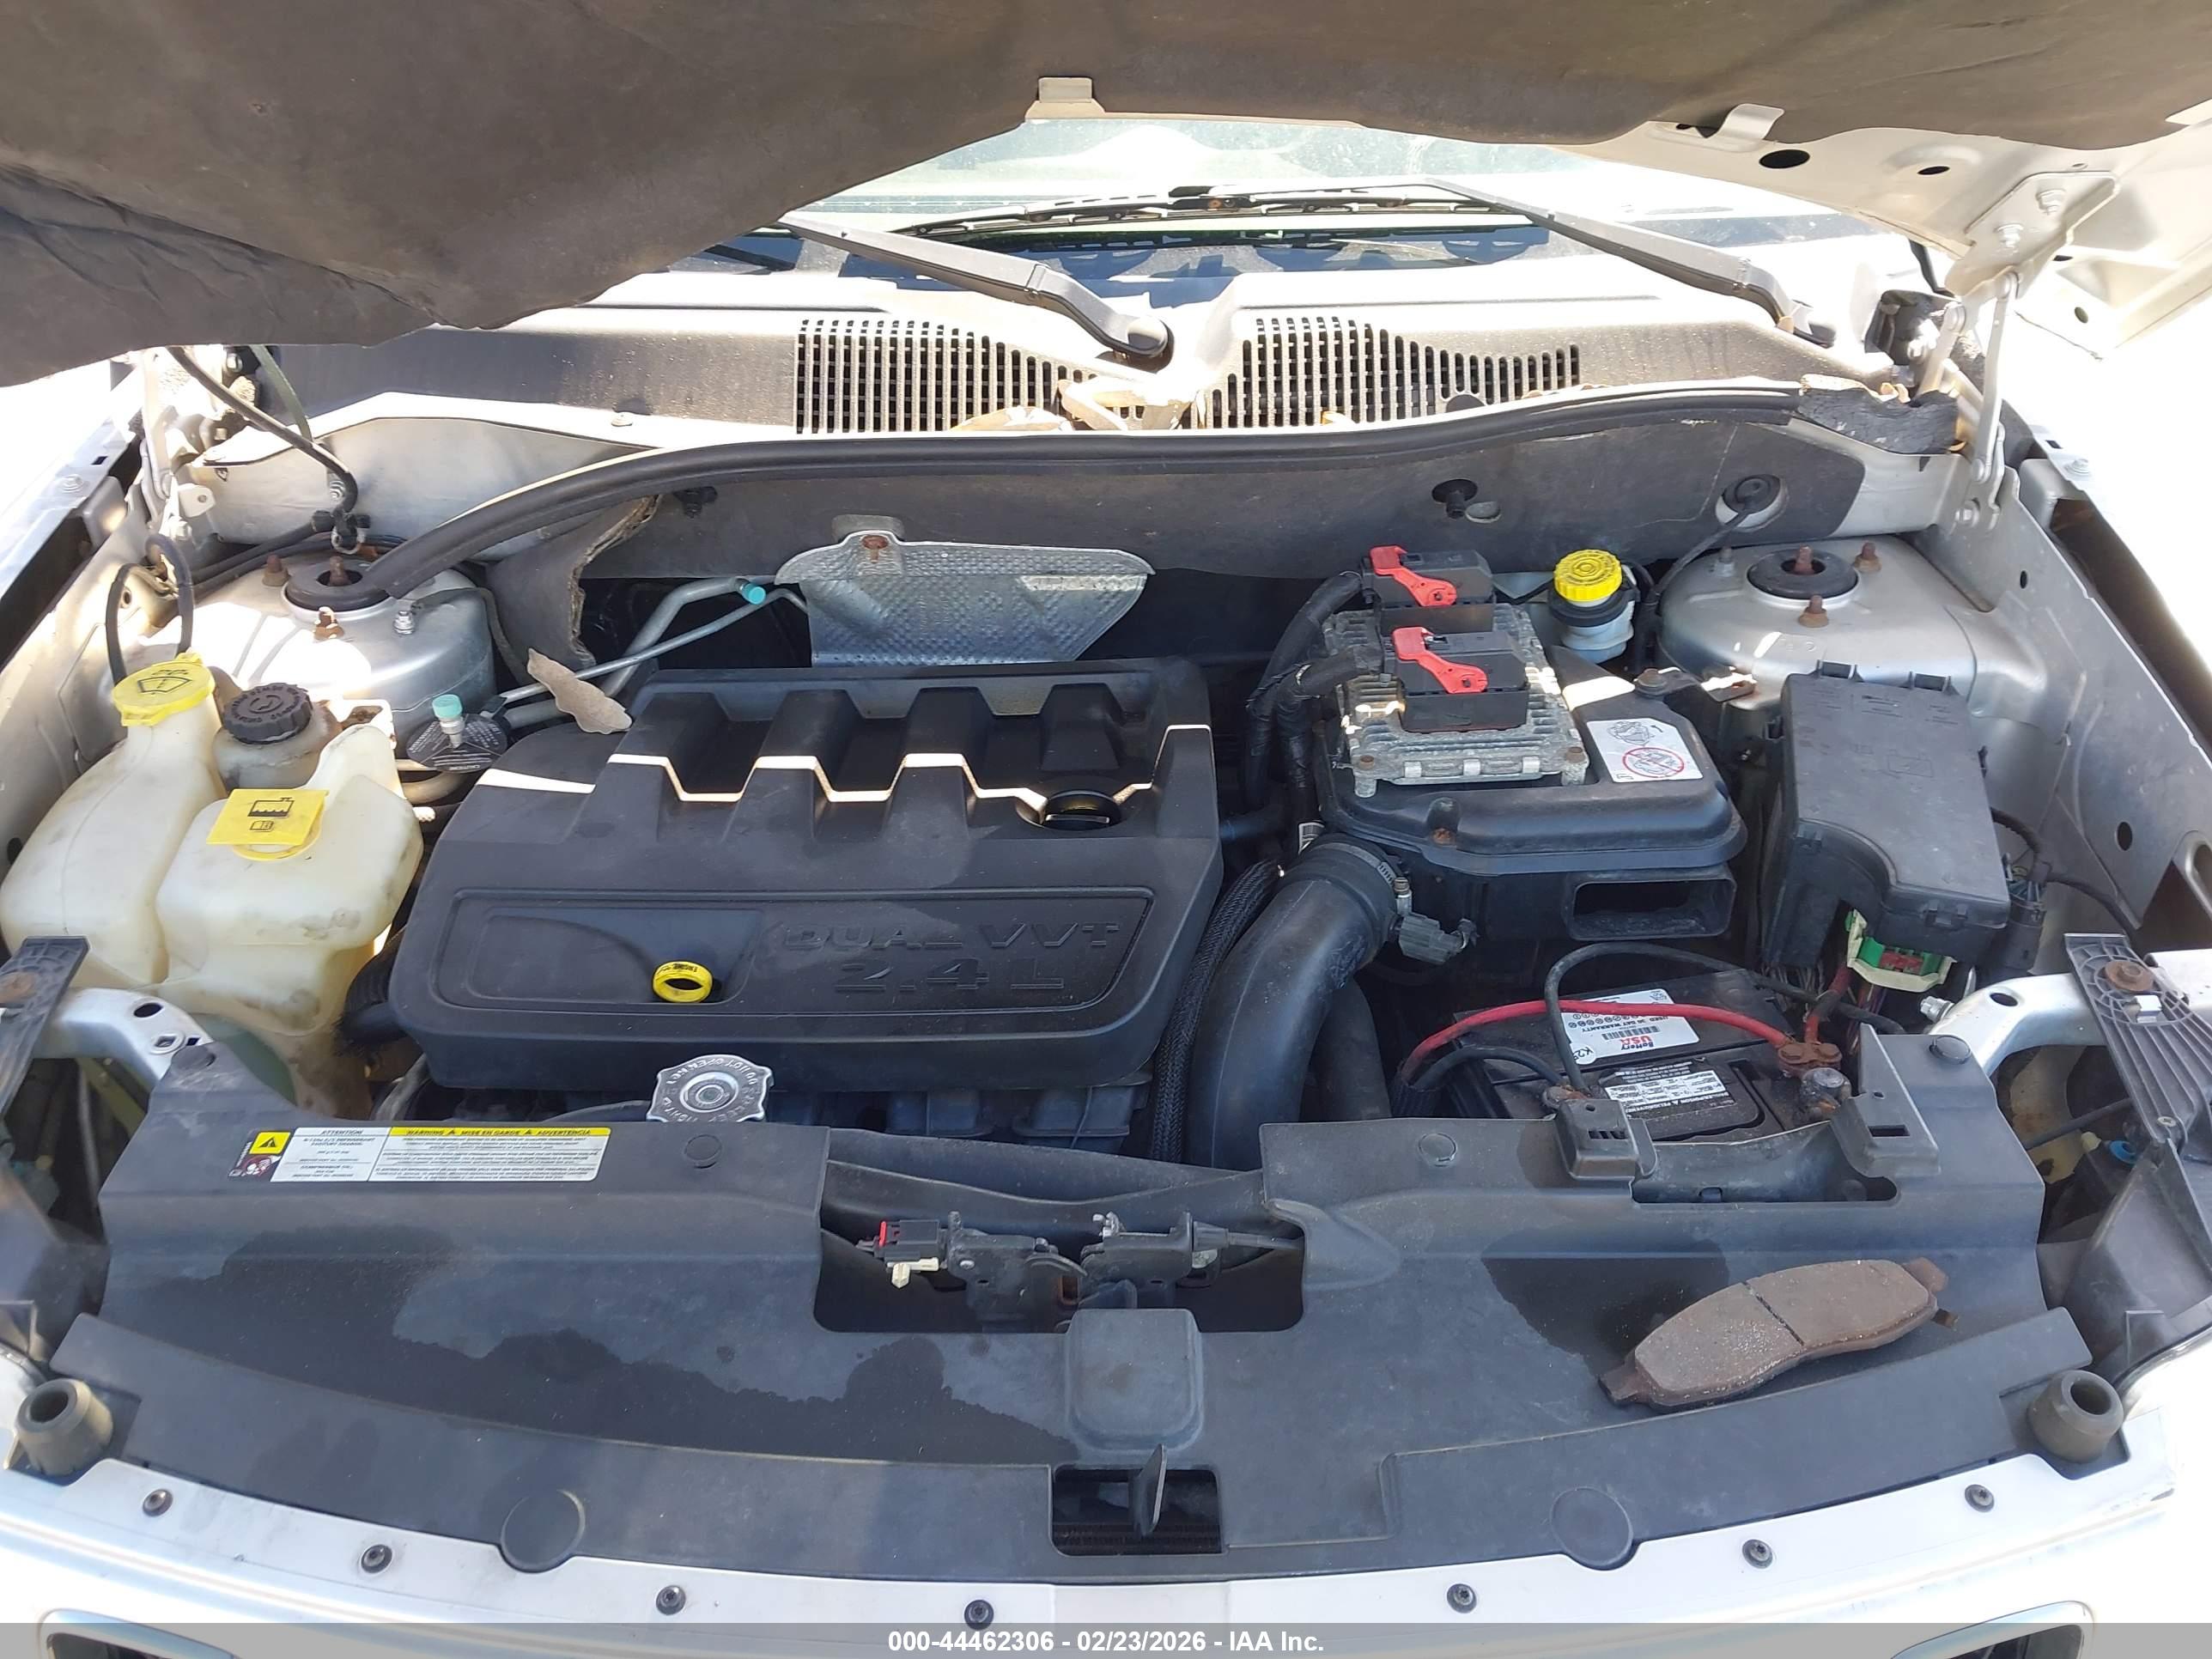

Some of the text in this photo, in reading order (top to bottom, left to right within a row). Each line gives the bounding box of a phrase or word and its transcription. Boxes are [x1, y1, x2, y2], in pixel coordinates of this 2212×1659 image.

[783, 922, 1121, 950] DUAL VVT
[1581, 1022, 1620, 1032] WARRANTY
[1620, 1036, 1652, 1045] USA
[1620, 1042, 1654, 1051] Battery
[687, 1057, 725, 1071] OPEN
